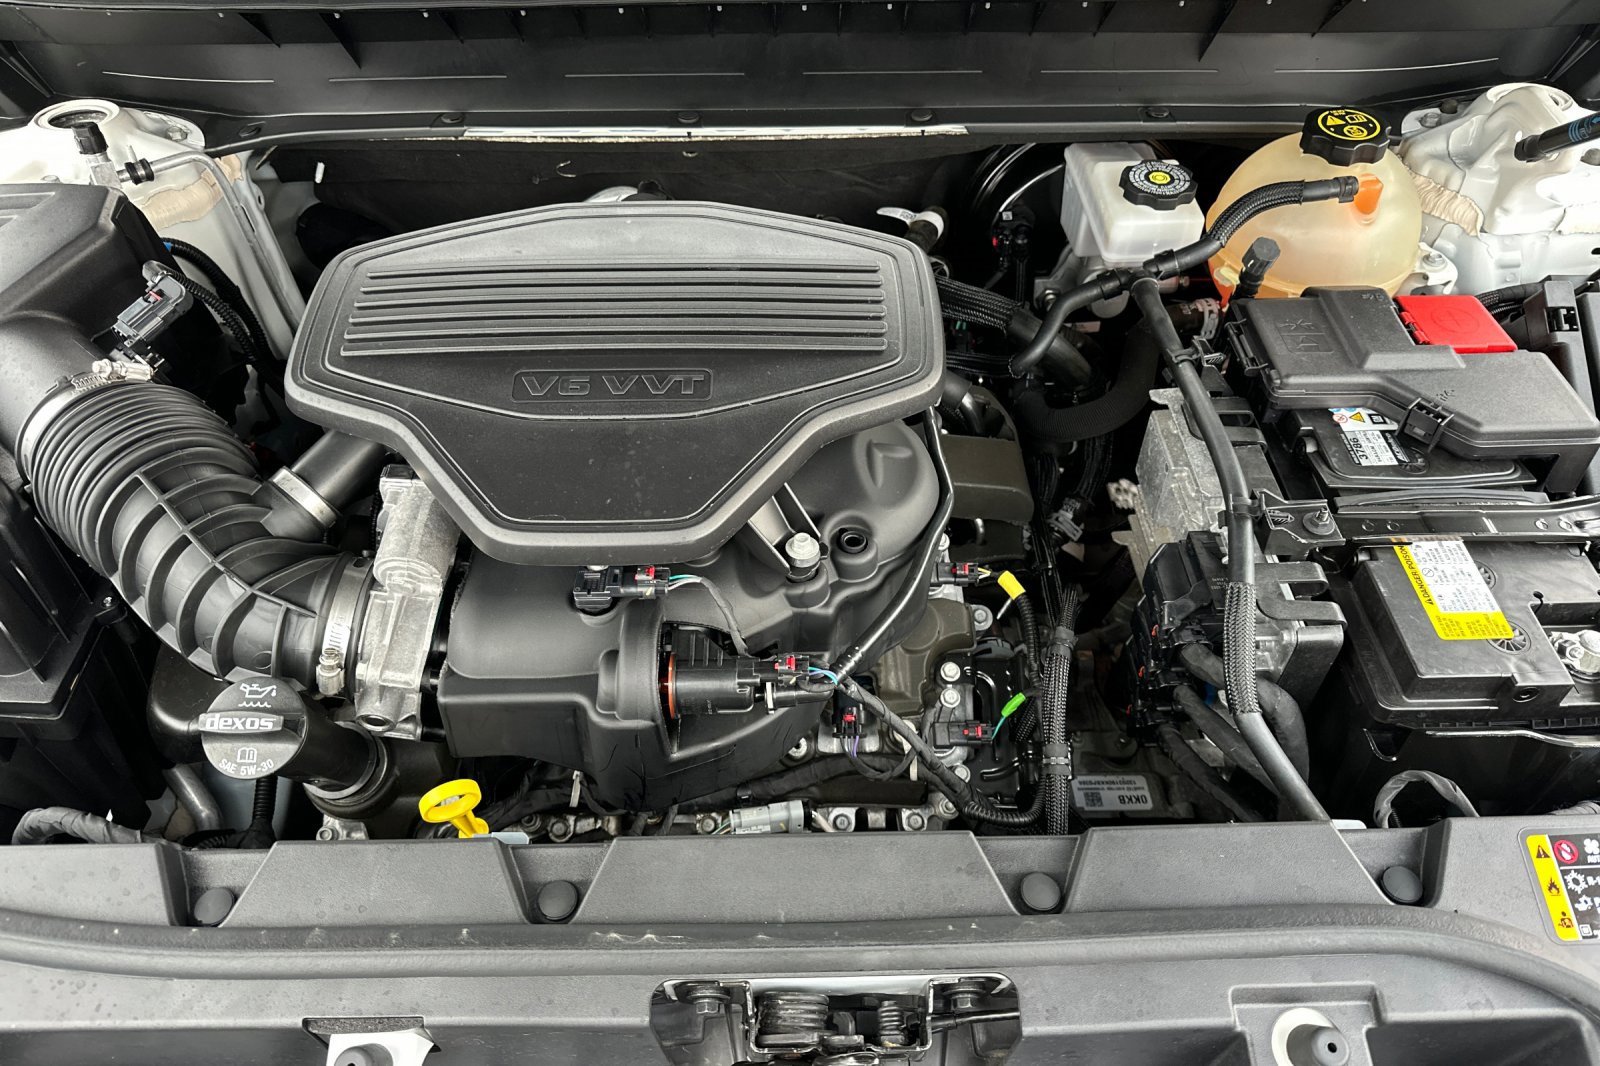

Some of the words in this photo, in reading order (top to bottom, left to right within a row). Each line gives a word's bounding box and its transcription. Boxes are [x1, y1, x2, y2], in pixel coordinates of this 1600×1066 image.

[522, 376, 590, 396] V6
[602, 375, 704, 394] VVT
[1349, 437, 1369, 460] 3786
[206, 713, 277, 730] dexos
[219, 759, 237, 774] SAE
[240, 759, 274, 776] 5W-30
